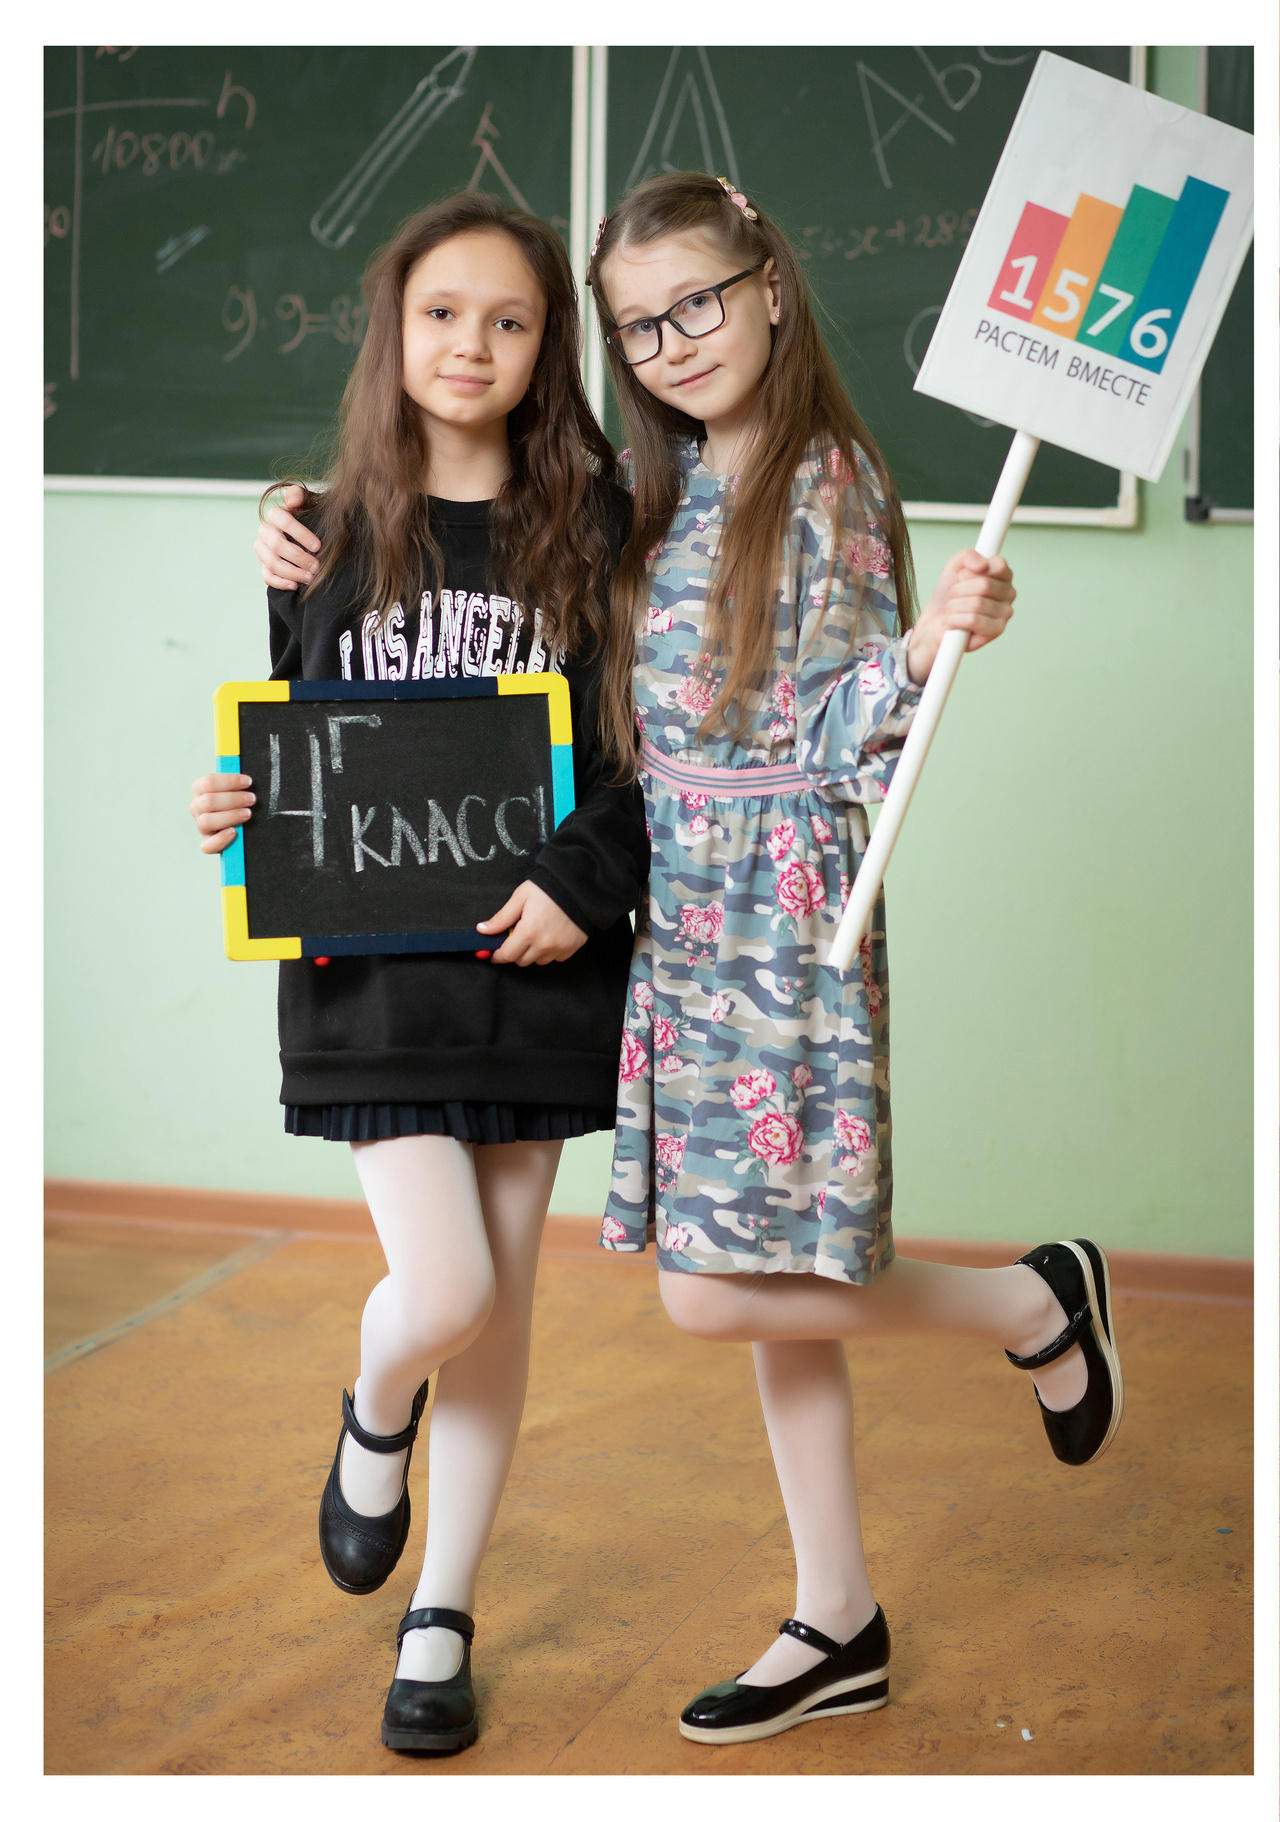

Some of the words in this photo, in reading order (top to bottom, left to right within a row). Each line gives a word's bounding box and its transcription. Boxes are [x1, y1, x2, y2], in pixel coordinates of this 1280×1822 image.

[1000, 254, 1172, 358] 1576
[974, 319, 1060, 370] РАСТЕМ
[1066, 355, 1152, 406] ВМЕСТЕ
